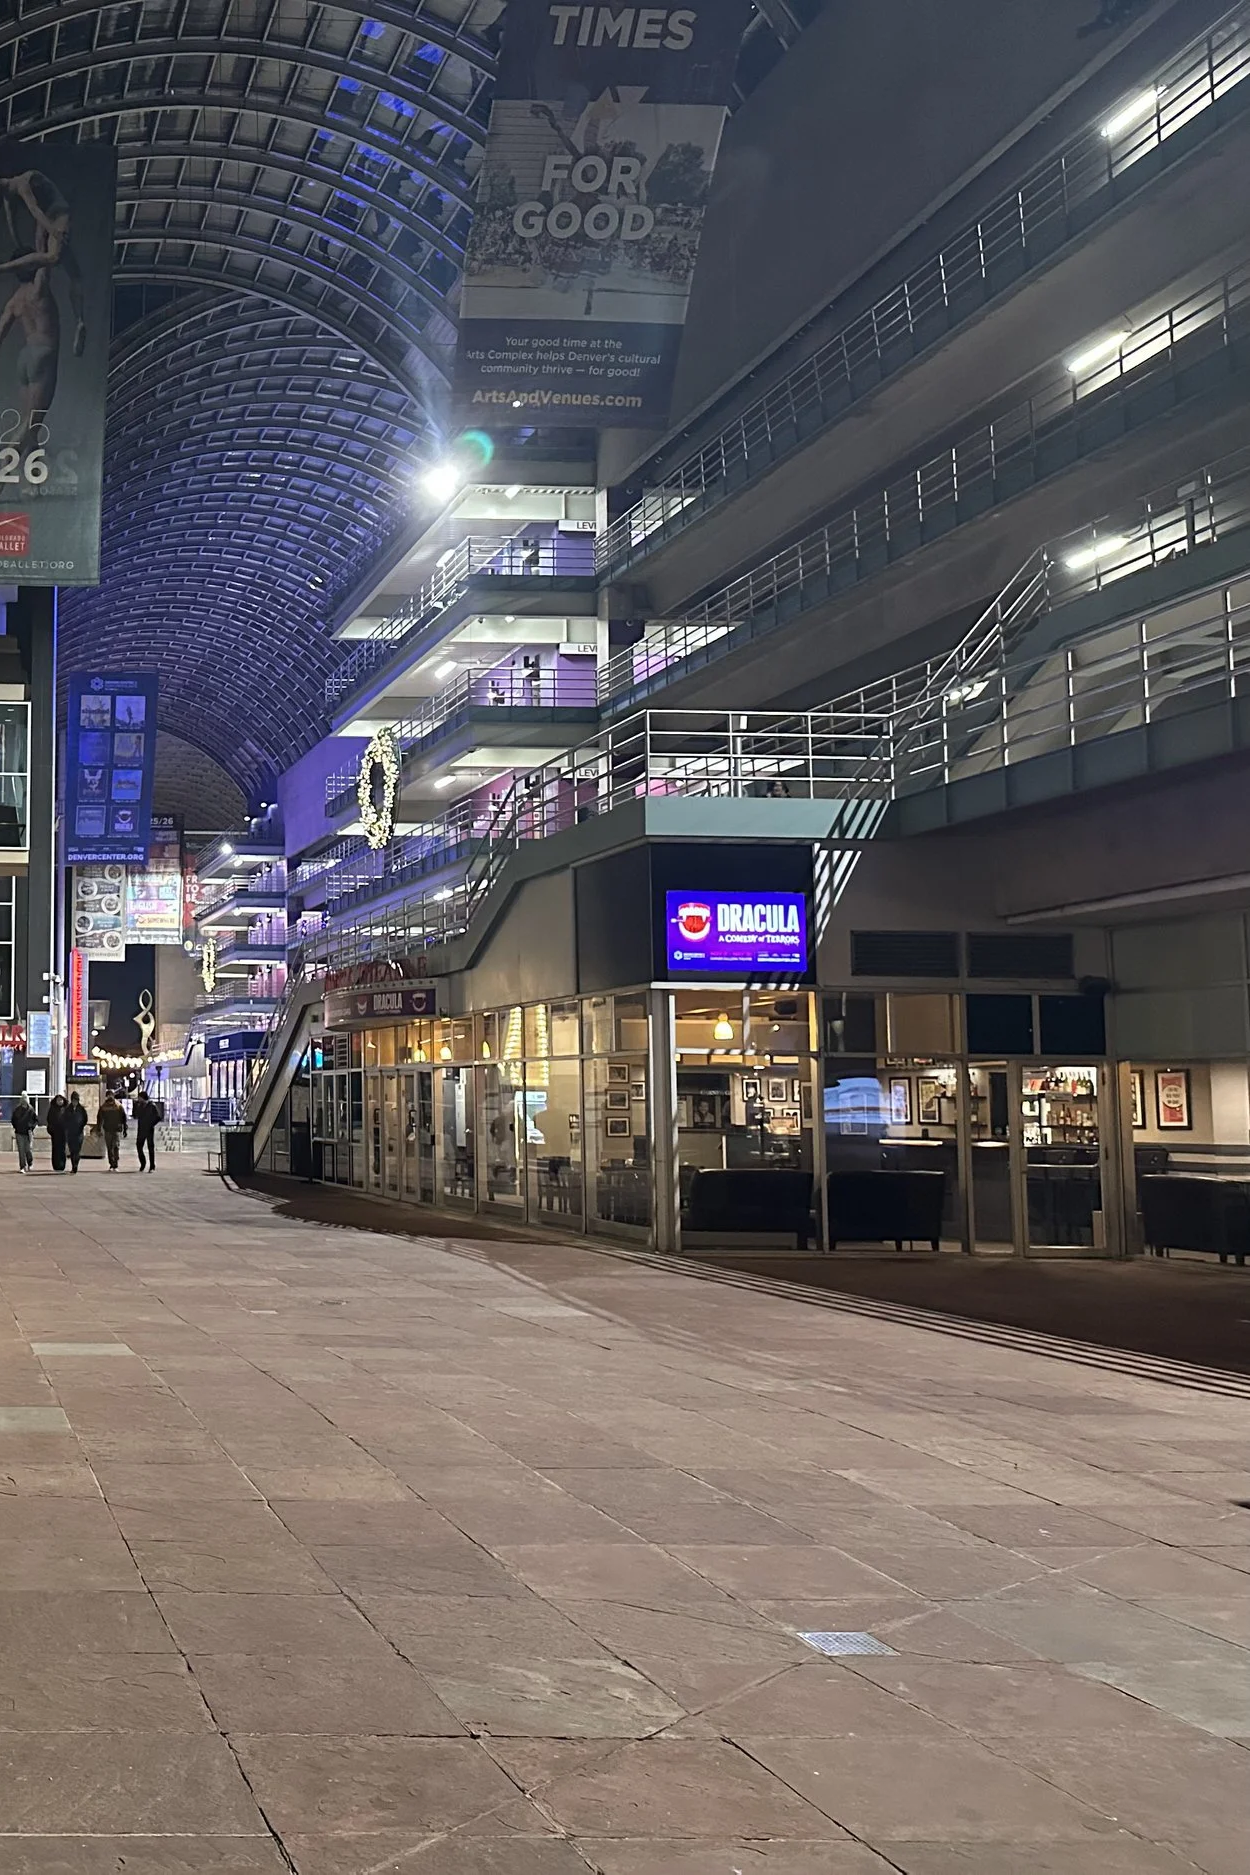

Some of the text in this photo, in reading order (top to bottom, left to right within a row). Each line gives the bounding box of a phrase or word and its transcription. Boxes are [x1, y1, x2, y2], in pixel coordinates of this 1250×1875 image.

[550, 5, 697, 50] TIMES
[542, 155, 642, 194] FOR
[513, 201, 654, 240] GOOD
[506, 336, 622, 349] Your good time at the
[488, 350, 533, 362] Complex
[536, 350, 565, 362] helps
[568, 351, 615, 362] Denver's
[618, 353, 661, 365] cultural
[481, 364, 538, 376] community
[542, 364, 573, 375] thrive
[588, 365, 604, 376] for
[607, 366, 641, 378] good!
[472, 390, 642, 407] ArtsAndVenues.com
[68, 853, 144, 861] DENVERCENTER.ORG
[185, 884, 200, 893] TO
[717, 904, 800, 933] DRACULA
[725, 934, 758, 943] COMEDY
[373, 992, 403, 1011] DRACULA
